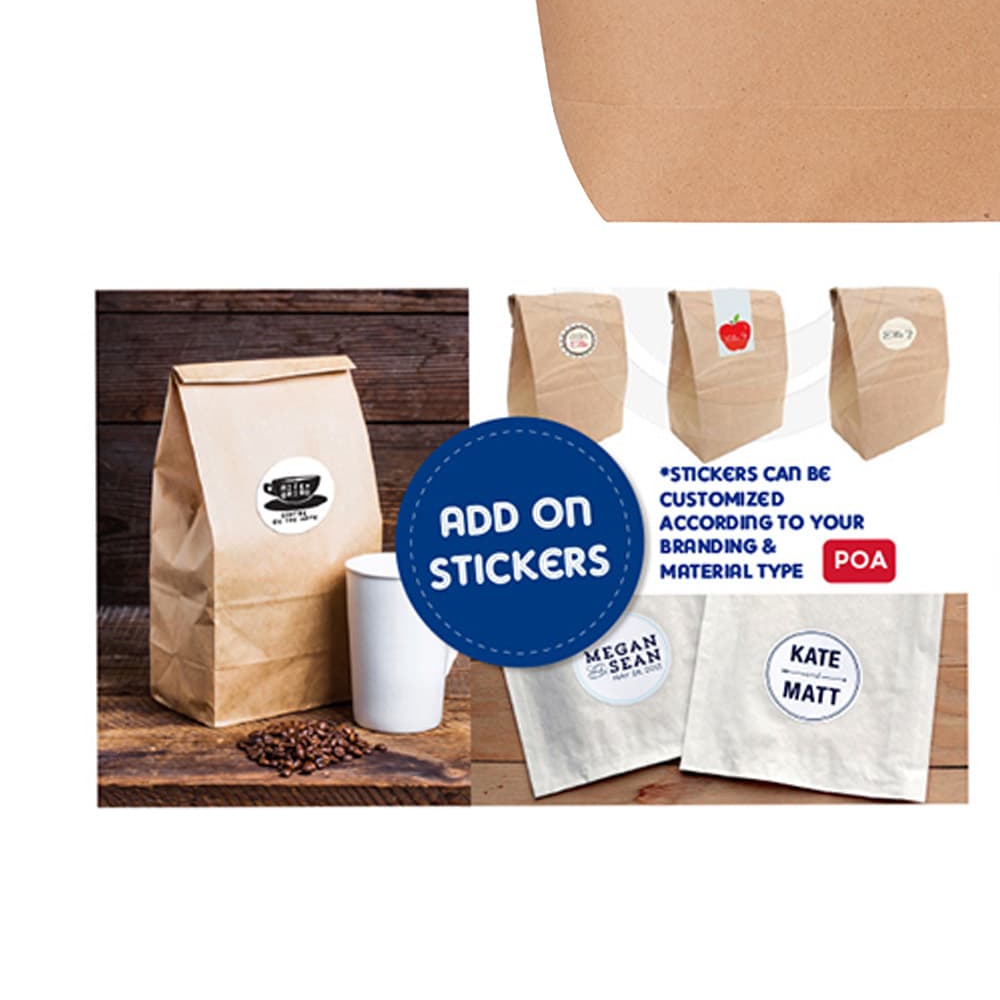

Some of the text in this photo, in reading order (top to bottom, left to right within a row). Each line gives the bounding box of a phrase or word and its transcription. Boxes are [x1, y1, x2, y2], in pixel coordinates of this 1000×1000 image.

[584, 634, 657, 664] MEGAN
[609, 648, 661, 674] SEAN
[790, 644, 841, 669] KATE
[782, 680, 841, 706] MATT
